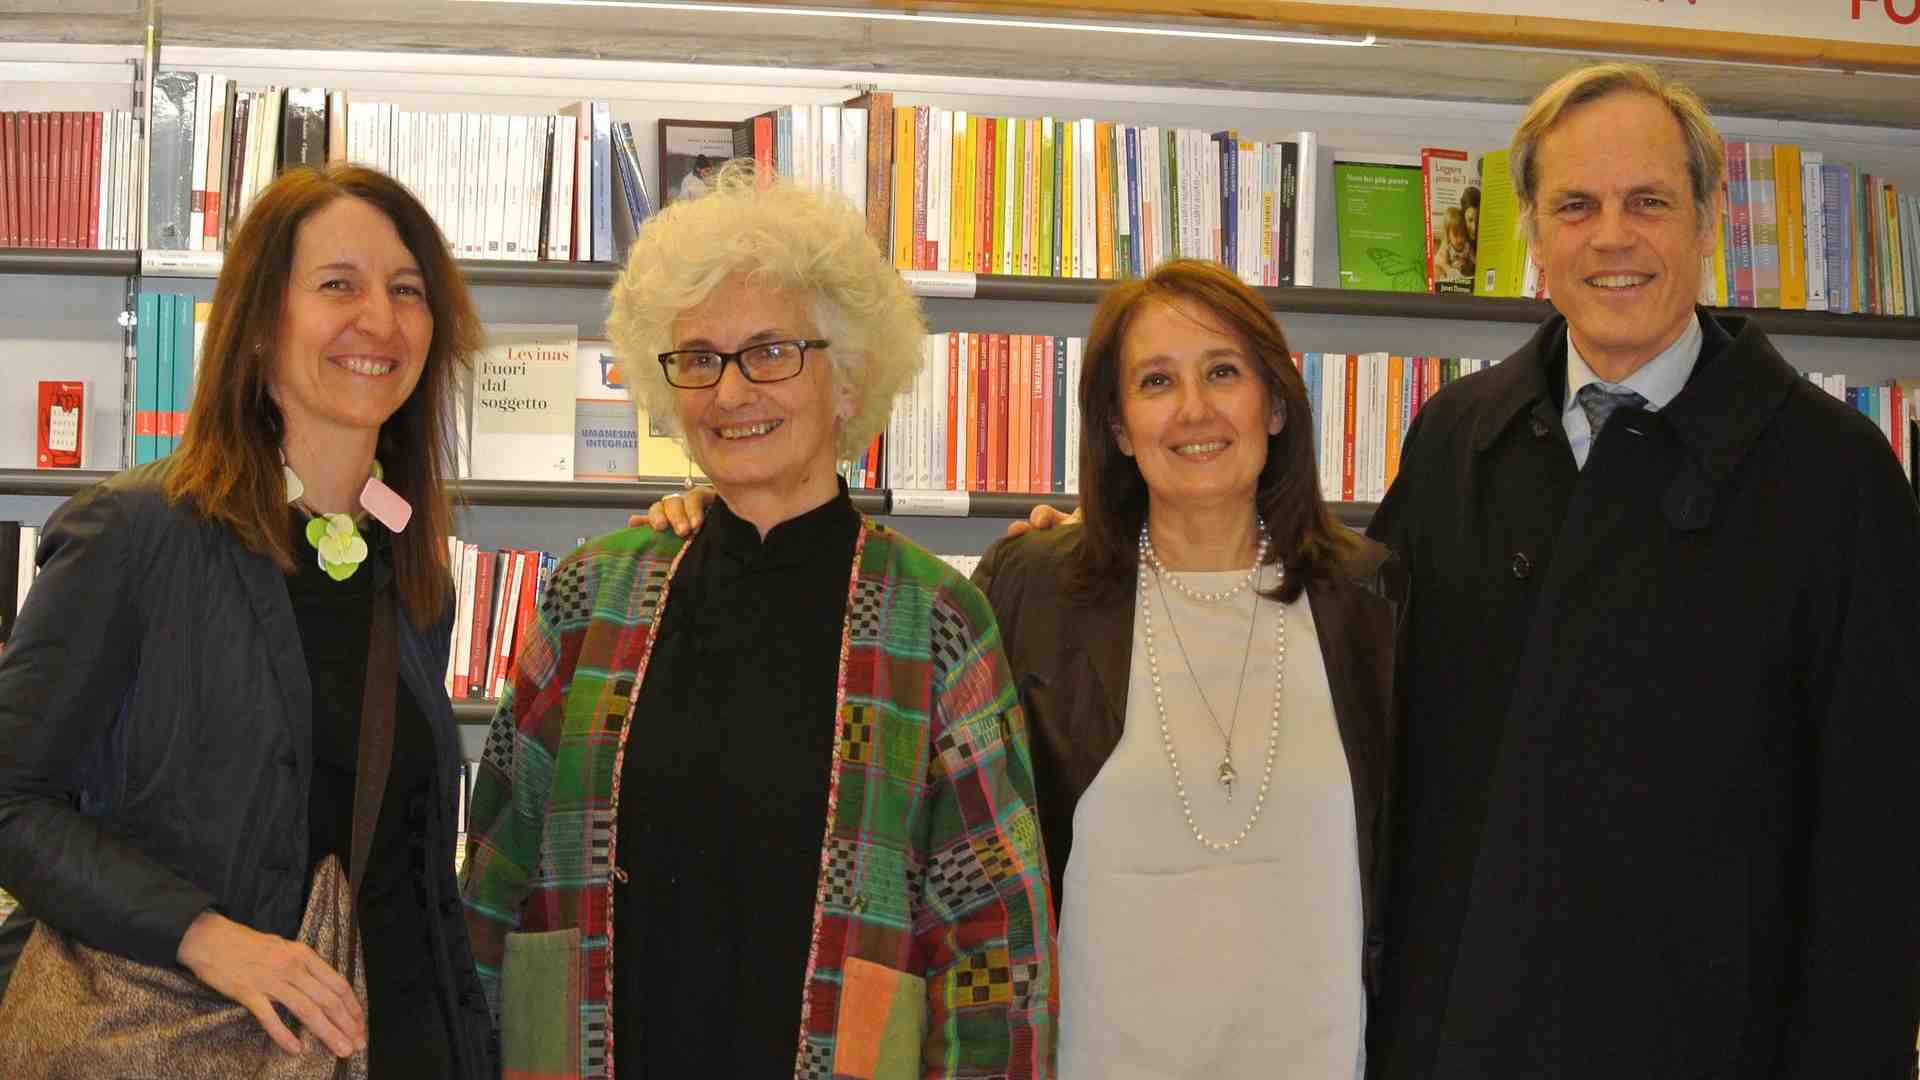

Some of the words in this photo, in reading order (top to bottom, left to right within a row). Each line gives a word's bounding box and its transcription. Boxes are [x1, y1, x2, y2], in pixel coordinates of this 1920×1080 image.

[507, 347, 569, 361] Levinas
[482, 361, 527, 376] Fuori
[481, 379, 507, 392] dal
[480, 398, 548, 412] soggetto
[581, 429, 637, 439] UMANESIM
